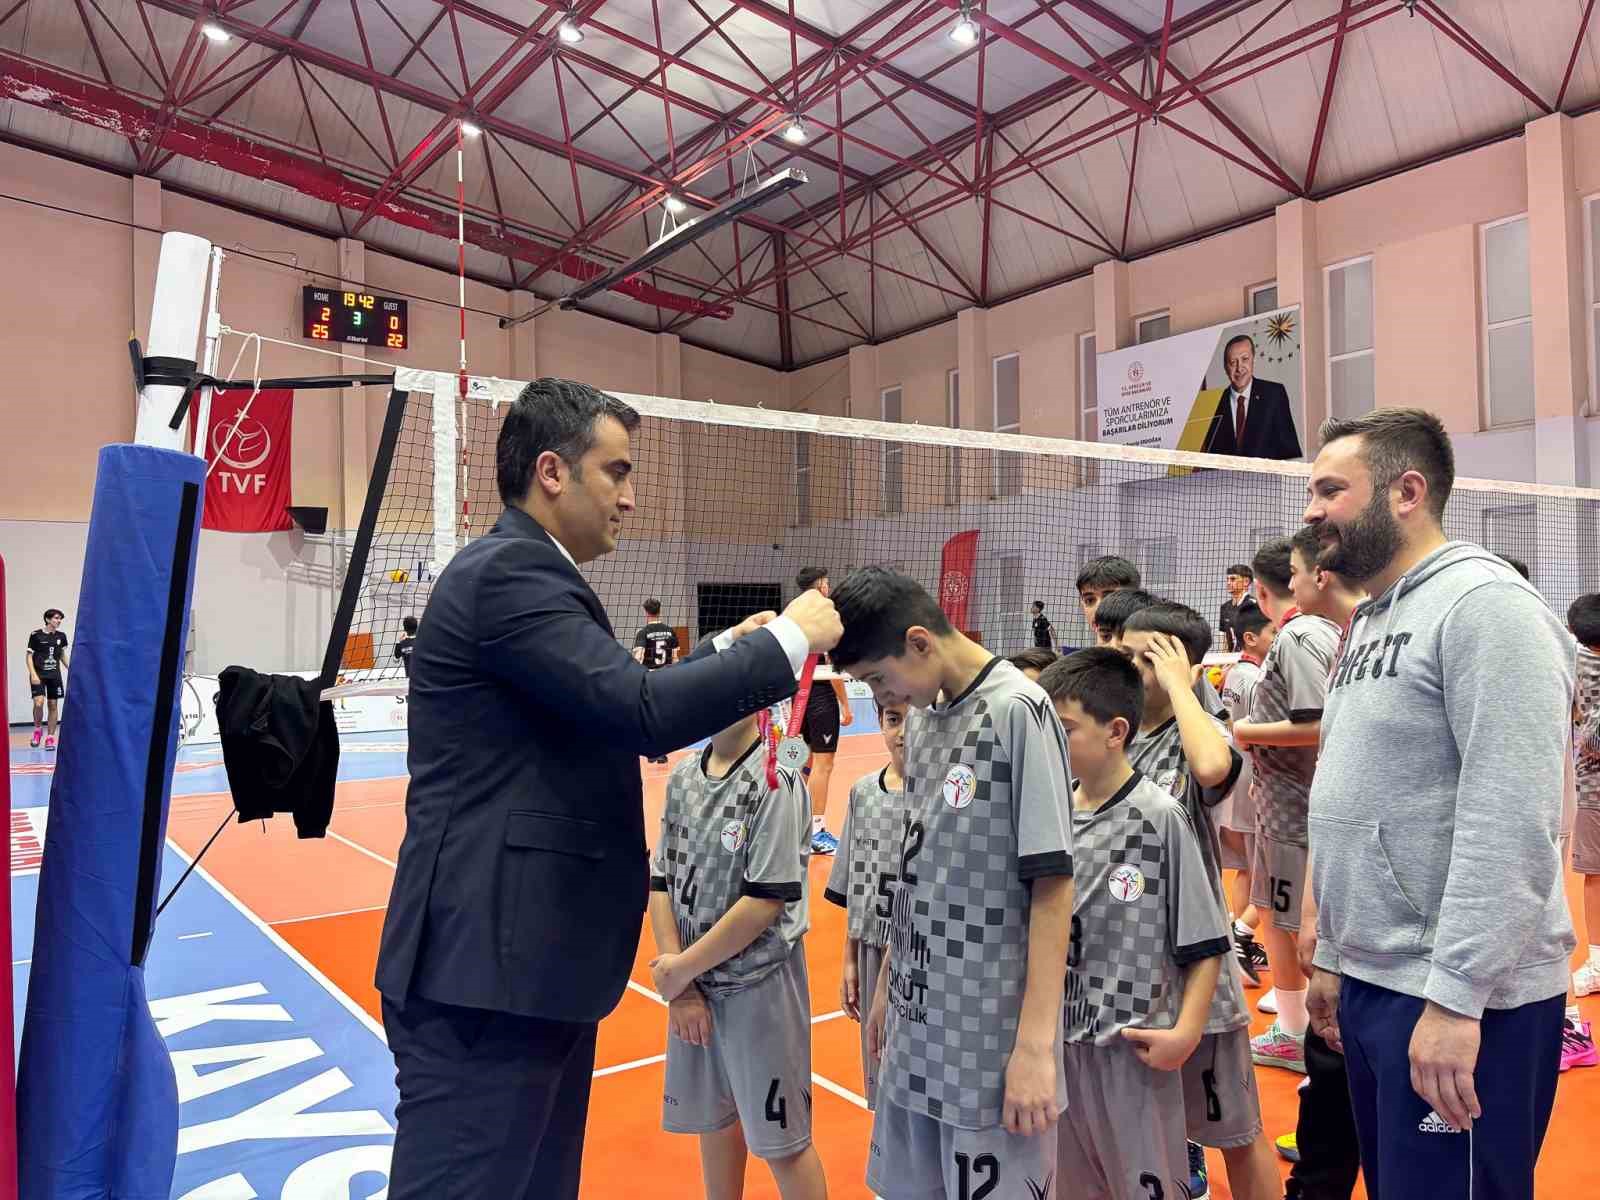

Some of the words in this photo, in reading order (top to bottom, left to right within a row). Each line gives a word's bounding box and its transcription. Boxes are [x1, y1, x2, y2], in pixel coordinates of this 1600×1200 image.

[344, 292, 355, 307] 19
[359, 294, 375, 309] 42
[383, 302, 398, 311] GUEST
[321, 307, 330, 321] 2
[353, 311, 362, 325] 3
[390, 316, 399, 330] 0
[312, 324, 329, 339] 25
[387, 333, 403, 348] 22
[1103, 407, 1120, 418] TÜM
[1121, 398, 1161, 414] ANTRENÖR
[1161, 396, 1172, 406] VE
[218, 471, 266, 494] TVF
[654, 640, 667, 665] 5
[681, 863, 698, 916] 4
[876, 871, 897, 918] 5
[1270, 875, 1292, 913] 15
[765, 1078, 787, 1129] 4
[954, 1151, 1001, 1200] 12
